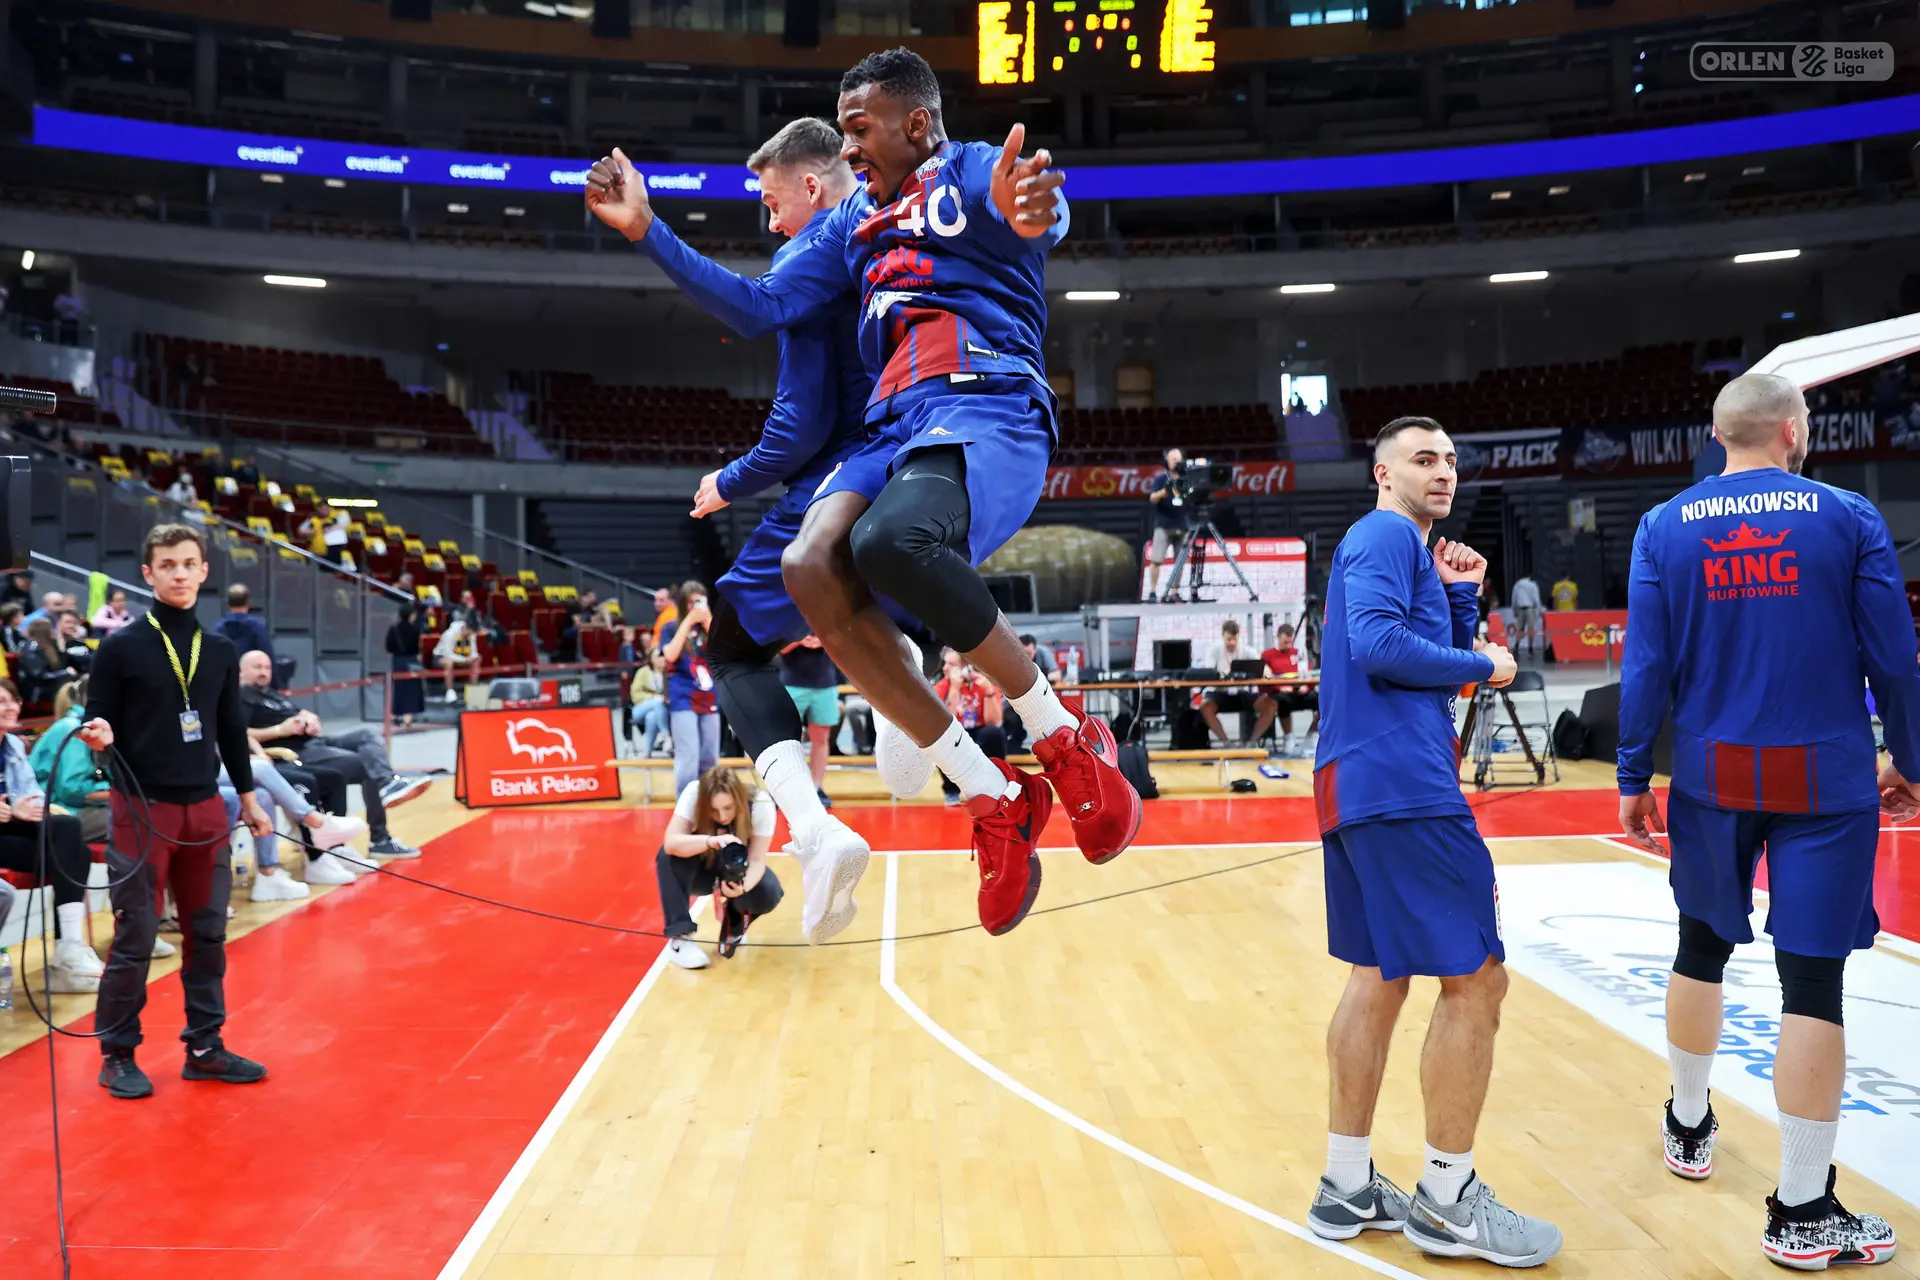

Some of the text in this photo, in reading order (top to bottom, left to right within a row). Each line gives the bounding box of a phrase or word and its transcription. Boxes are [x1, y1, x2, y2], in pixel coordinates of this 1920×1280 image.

[237, 146, 298, 165] eventim
[346, 155, 404, 174] eventim
[449, 163, 506, 181] eventim
[648, 173, 702, 190] eventim
[894, 184, 967, 237] 40
[1490, 440, 1560, 469] PACK
[1630, 427, 1683, 466] WILKI
[1681, 491, 1819, 523] NOWAKOWSKI
[1703, 551, 1799, 588] KING
[1707, 584, 1800, 600] HURTOWNIE
[491, 774, 599, 797] Bank Pekao
